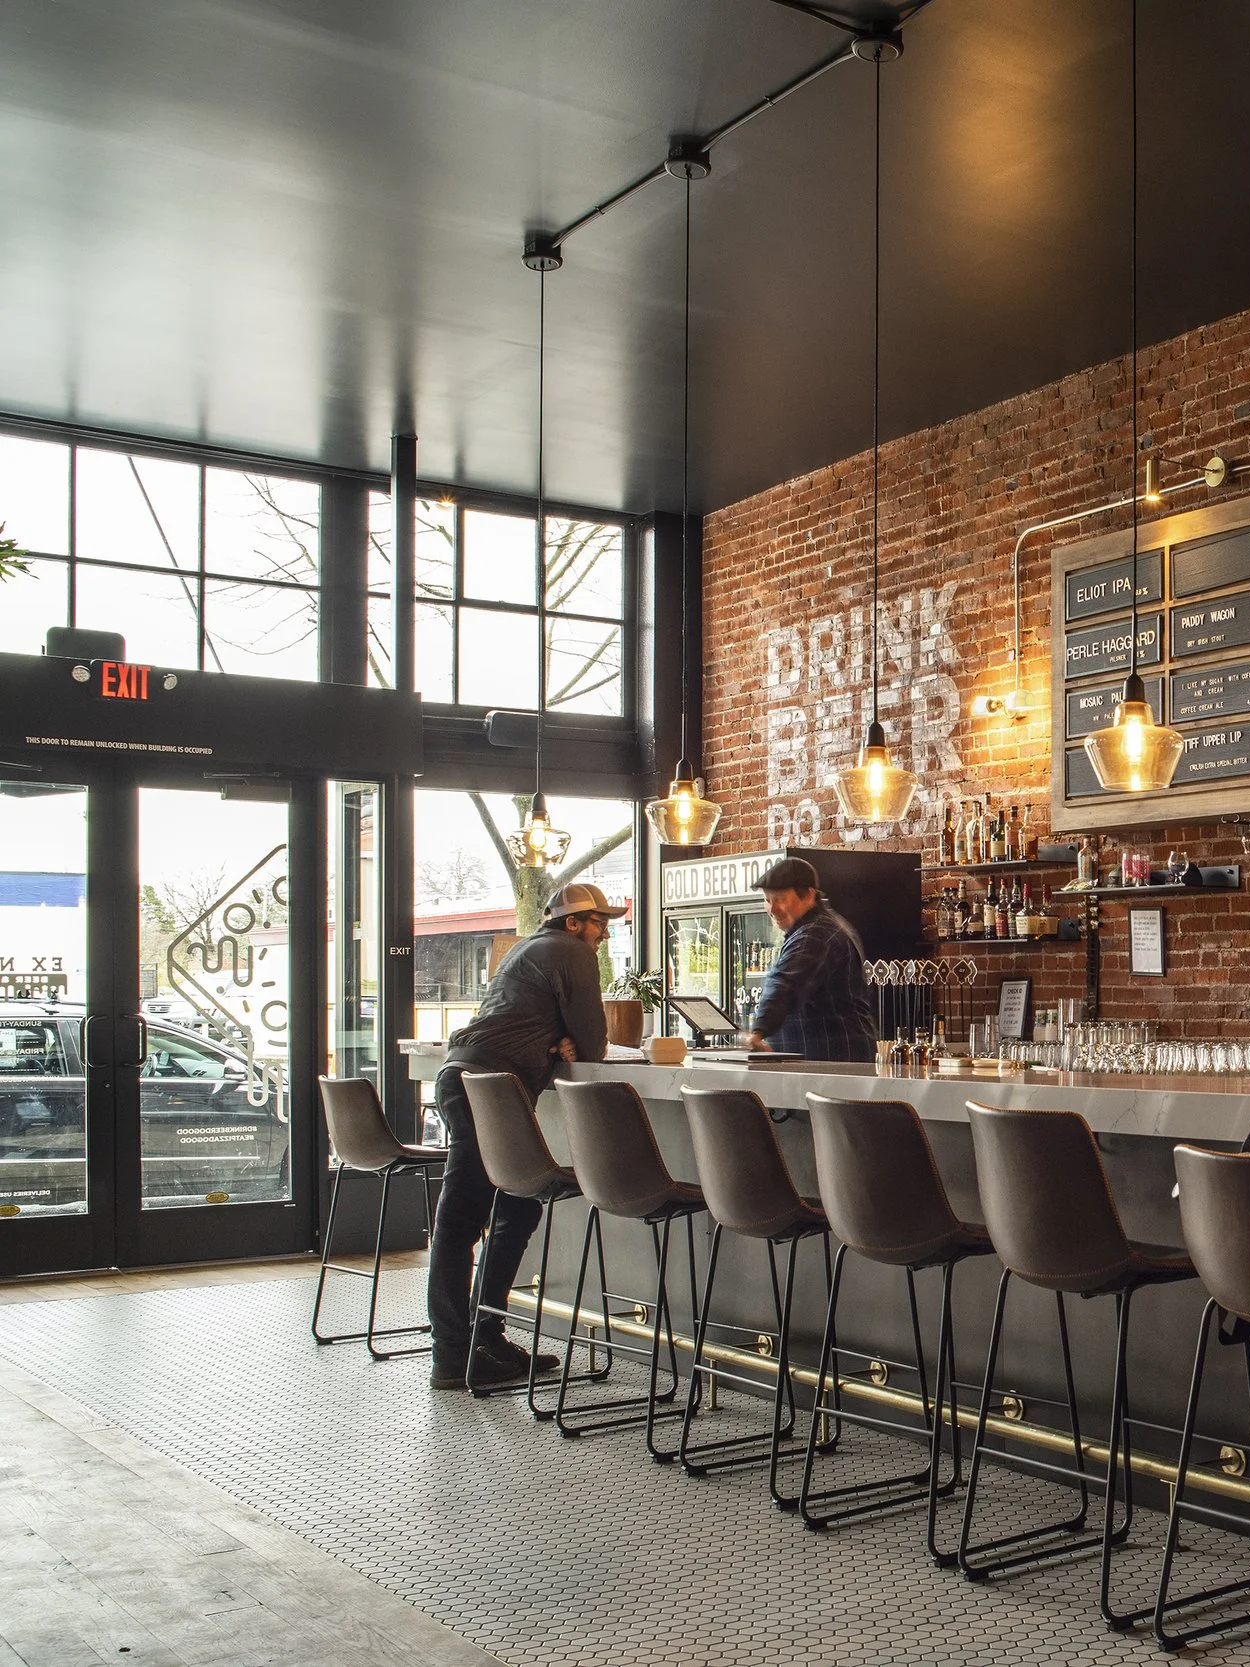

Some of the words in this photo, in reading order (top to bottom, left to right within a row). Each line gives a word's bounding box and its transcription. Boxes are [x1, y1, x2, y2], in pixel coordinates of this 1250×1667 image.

[1077, 582, 1107, 602] ELIOT
[1112, 577, 1131, 594] IPA
[1181, 613, 1204, 629] PADDY
[1211, 607, 1235, 624] WAGON
[767, 581, 962, 700] DRINK
[1211, 634, 1225, 644] STOUT
[1067, 642, 1099, 661] PERLE
[102, 662, 151, 700] EXIT
[1187, 681, 1198, 690] LIKE
[1228, 674, 1239, 682] WITH
[1080, 695, 1103, 709] MOSAIC
[1111, 692, 1124, 704] PAL
[1208, 687, 1224, 696] CREAM
[1180, 706, 1197, 715] COFFEE
[1199, 703, 1214, 712] CREAM
[767, 673, 962, 797] BEER
[1183, 737, 1199, 754] TIFF
[1203, 733, 1226, 748] UPPER
[1229, 730, 1242, 744] LIP
[25, 736, 41, 744] THIS
[41, 738, 60, 746] DOOR
[70, 739, 95, 748] REMAIN
[95, 741, 128, 749] UNLOCKED
[148, 744, 177, 753] BUILDING
[184, 746, 213, 755] OCCUPIED
[1233, 757, 1248, 766] BITTER
[666, 868, 698, 900] COLD
[703, 863, 737, 897] BEER
[742, 860, 759, 892] TO
[390, 947, 411, 955] EXIT
